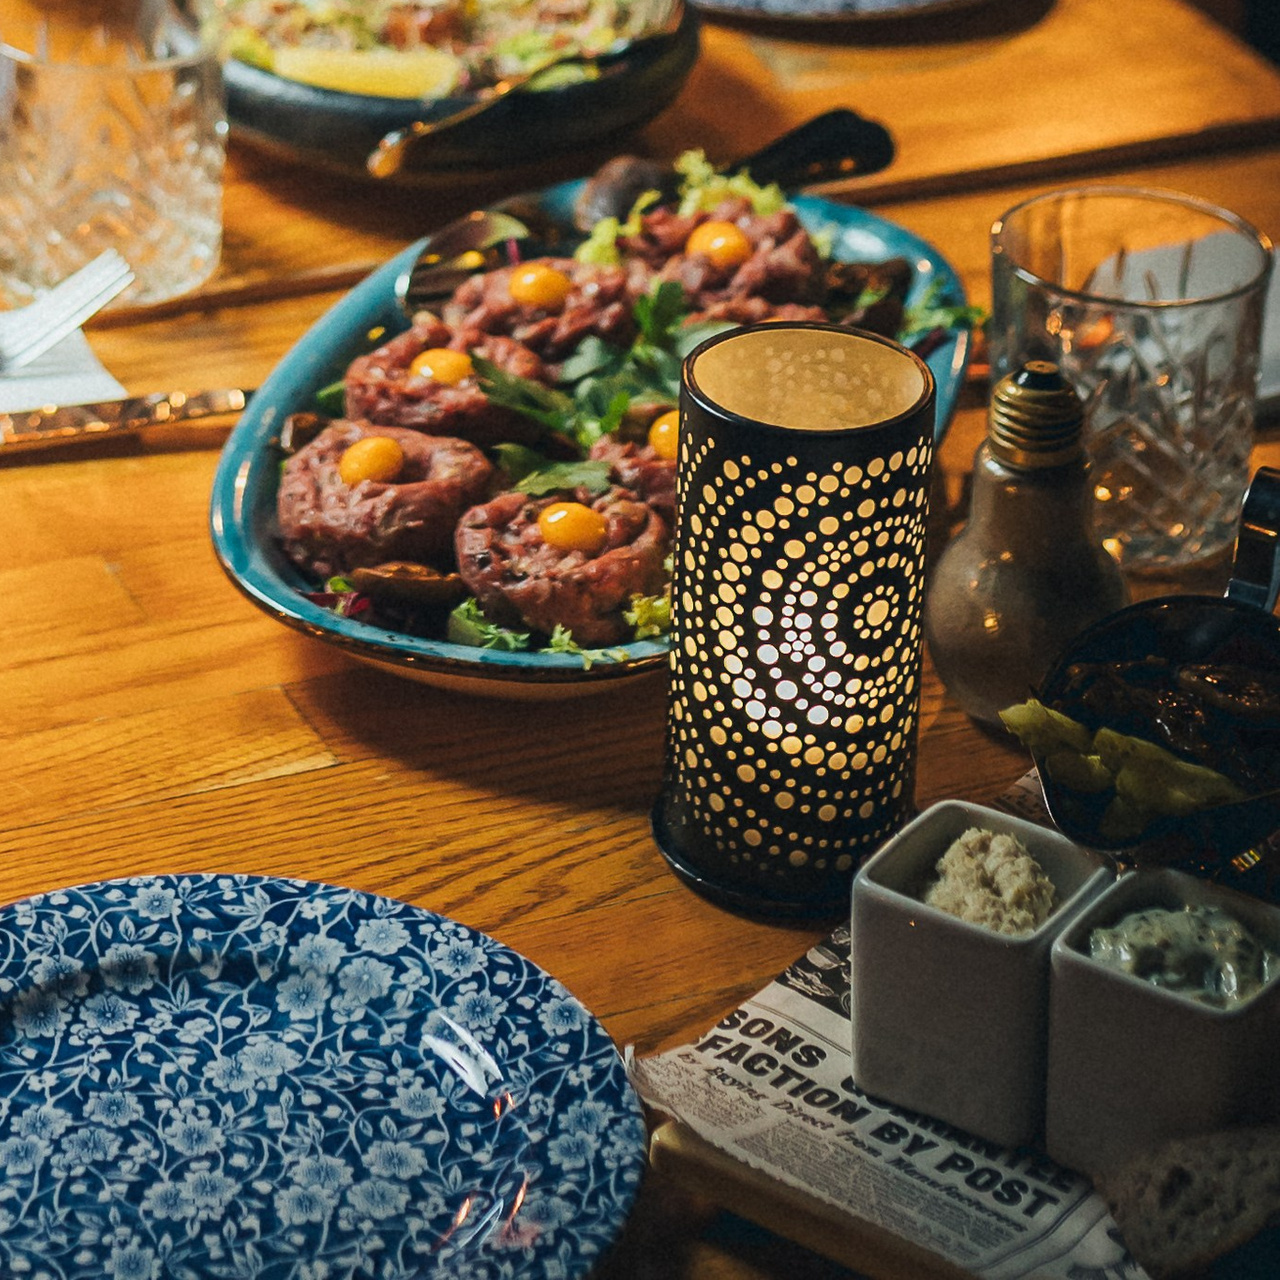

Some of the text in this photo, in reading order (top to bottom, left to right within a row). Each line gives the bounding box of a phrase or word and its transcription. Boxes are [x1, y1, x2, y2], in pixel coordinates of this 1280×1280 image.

[716, 1008, 827, 1068] SONS
[695, 1034, 872, 1125] FACTION
[870, 1120, 939, 1157] BY
[934, 1151, 1061, 1218] POST
[771, 1099, 835, 1131] Direct
